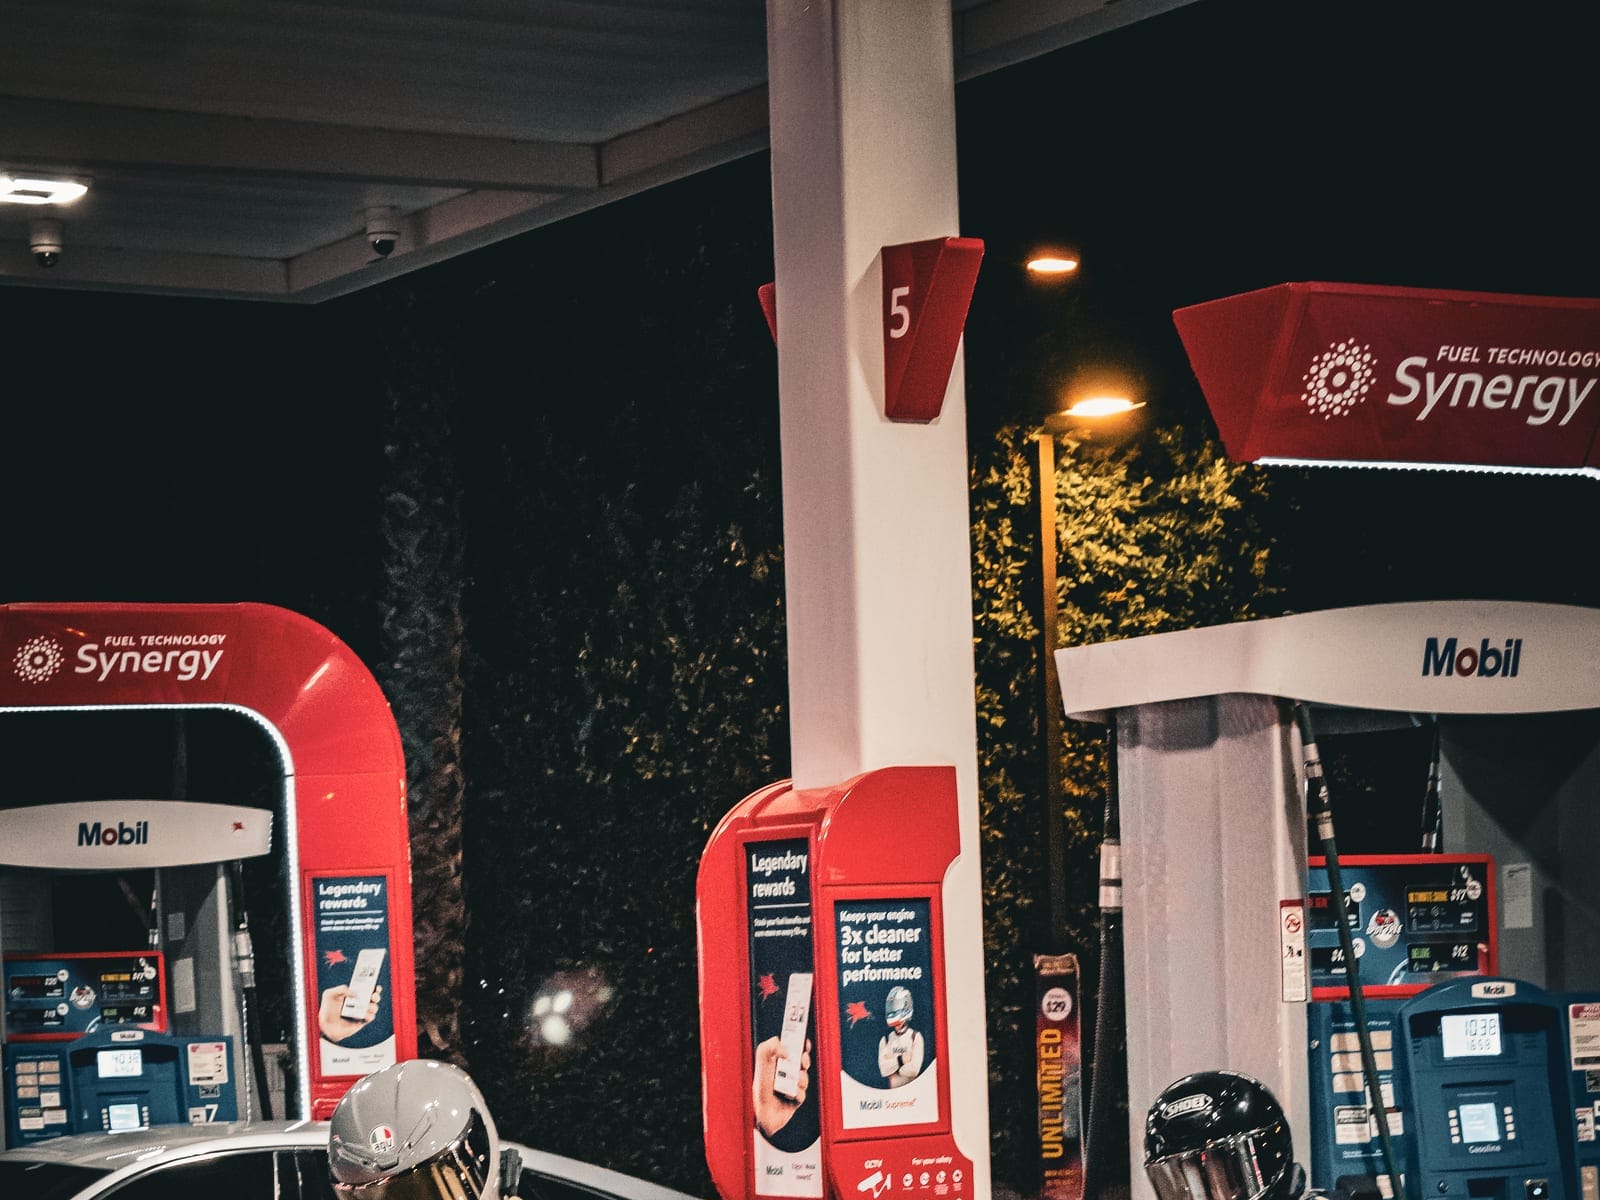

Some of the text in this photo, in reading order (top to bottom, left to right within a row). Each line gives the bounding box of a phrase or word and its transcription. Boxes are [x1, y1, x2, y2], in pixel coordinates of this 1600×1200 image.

[889, 286, 910, 338] 5
[1437, 345, 1480, 363] FUEL
[1388, 355, 1598, 426] Synergy
[104, 634, 226, 647] FUEL TECHNOLOGY
[74, 643, 225, 682] Synergy
[1422, 637, 1522, 679] Mobil
[77, 821, 148, 847] Mobil
[752, 850, 808, 877] Legendary
[319, 882, 382, 897] Legendary
[752, 876, 796, 898] rewards
[319, 896, 368, 910] rewards
[840, 908, 916, 925] Keeps your engine
[840, 923, 922, 946] 3x cleaner
[842, 946, 903, 964] for better
[843, 964, 922, 988] performance
[1483, 985, 1505, 994] Mobil
[1041, 1028, 1064, 1159] UNLIMITED
[860, 1099, 882, 1111] Mobil
[1166, 1095, 1206, 1117] SHOEI
